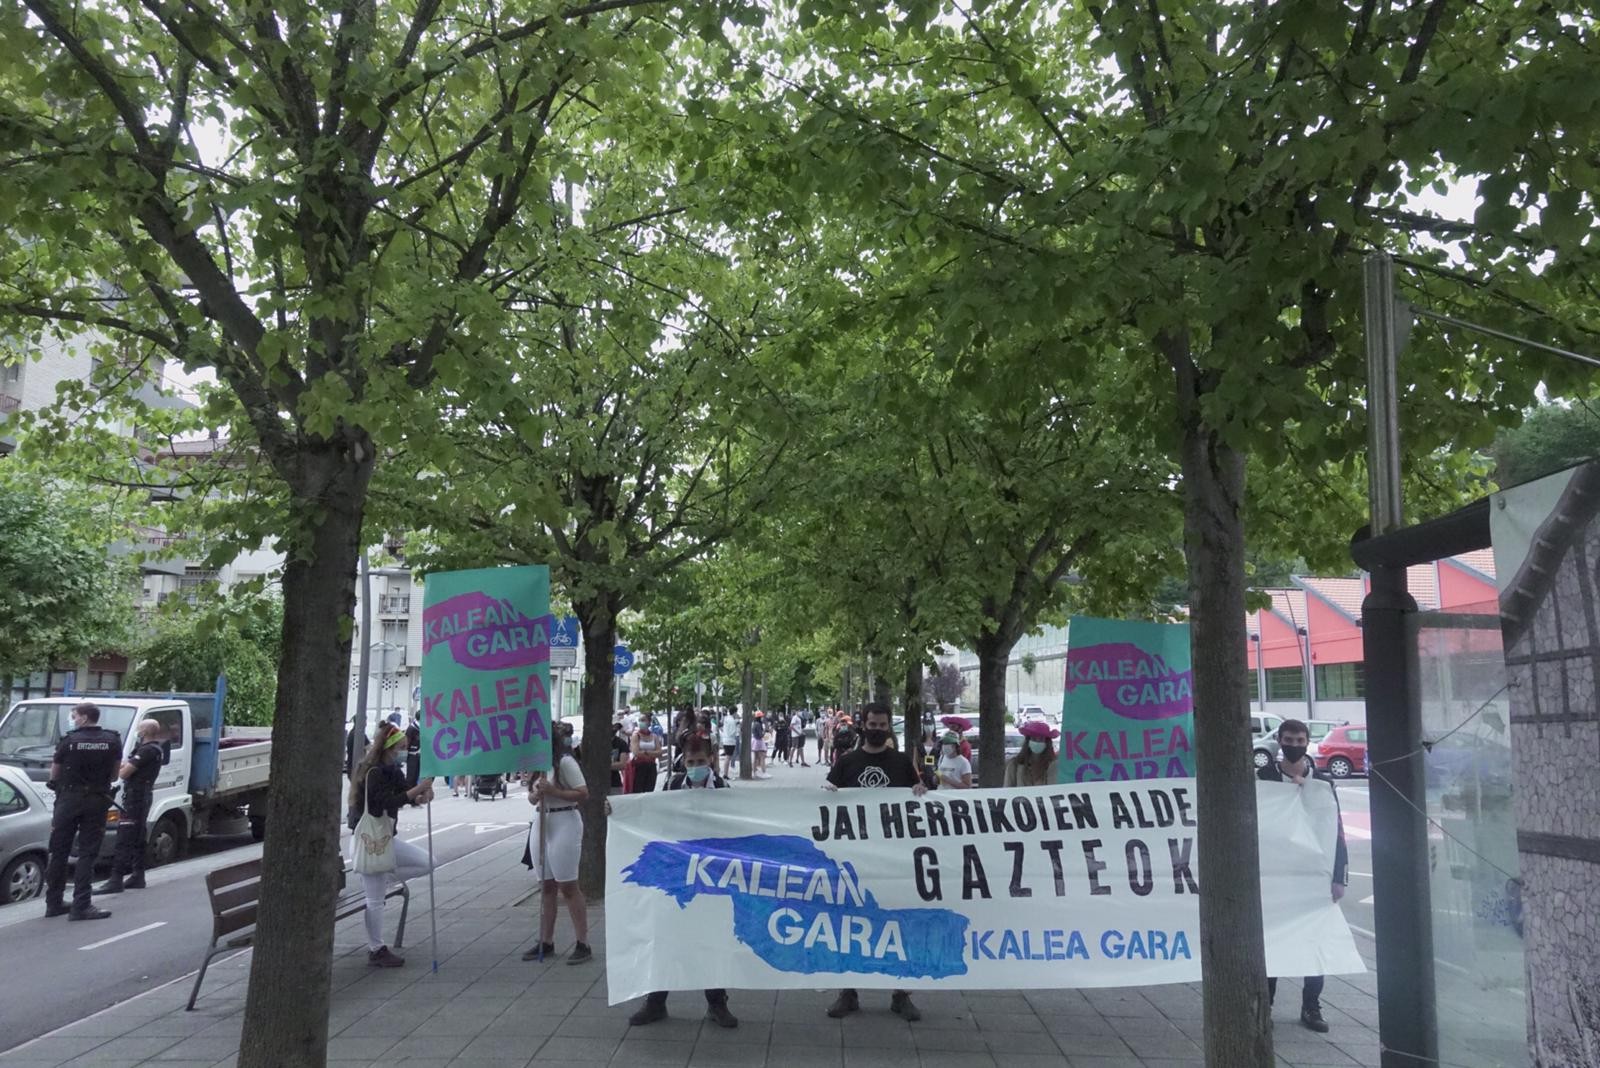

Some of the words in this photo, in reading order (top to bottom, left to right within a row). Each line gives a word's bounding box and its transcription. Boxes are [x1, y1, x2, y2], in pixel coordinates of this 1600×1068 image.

[424, 603, 520, 642] KALEAN
[467, 627, 549, 657] GARA
[1069, 659, 1169, 680] KALEAN
[424, 674, 548, 727] KALEA
[1117, 678, 1192, 706] GARA
[433, 708, 548, 761] GARA
[1064, 725, 1191, 761] KALEA
[1075, 756, 1188, 783] GARA
[811, 804, 868, 841] JAI
[880, 793, 1099, 839] HERRIKOIEN
[1111, 788, 1197, 830] ALDE
[686, 853, 864, 908] KALEAN
[913, 837, 1199, 902] GAZTEOK
[767, 907, 907, 962] GARA
[972, 929, 1090, 961] KALEA
[1100, 929, 1192, 961] GARA
